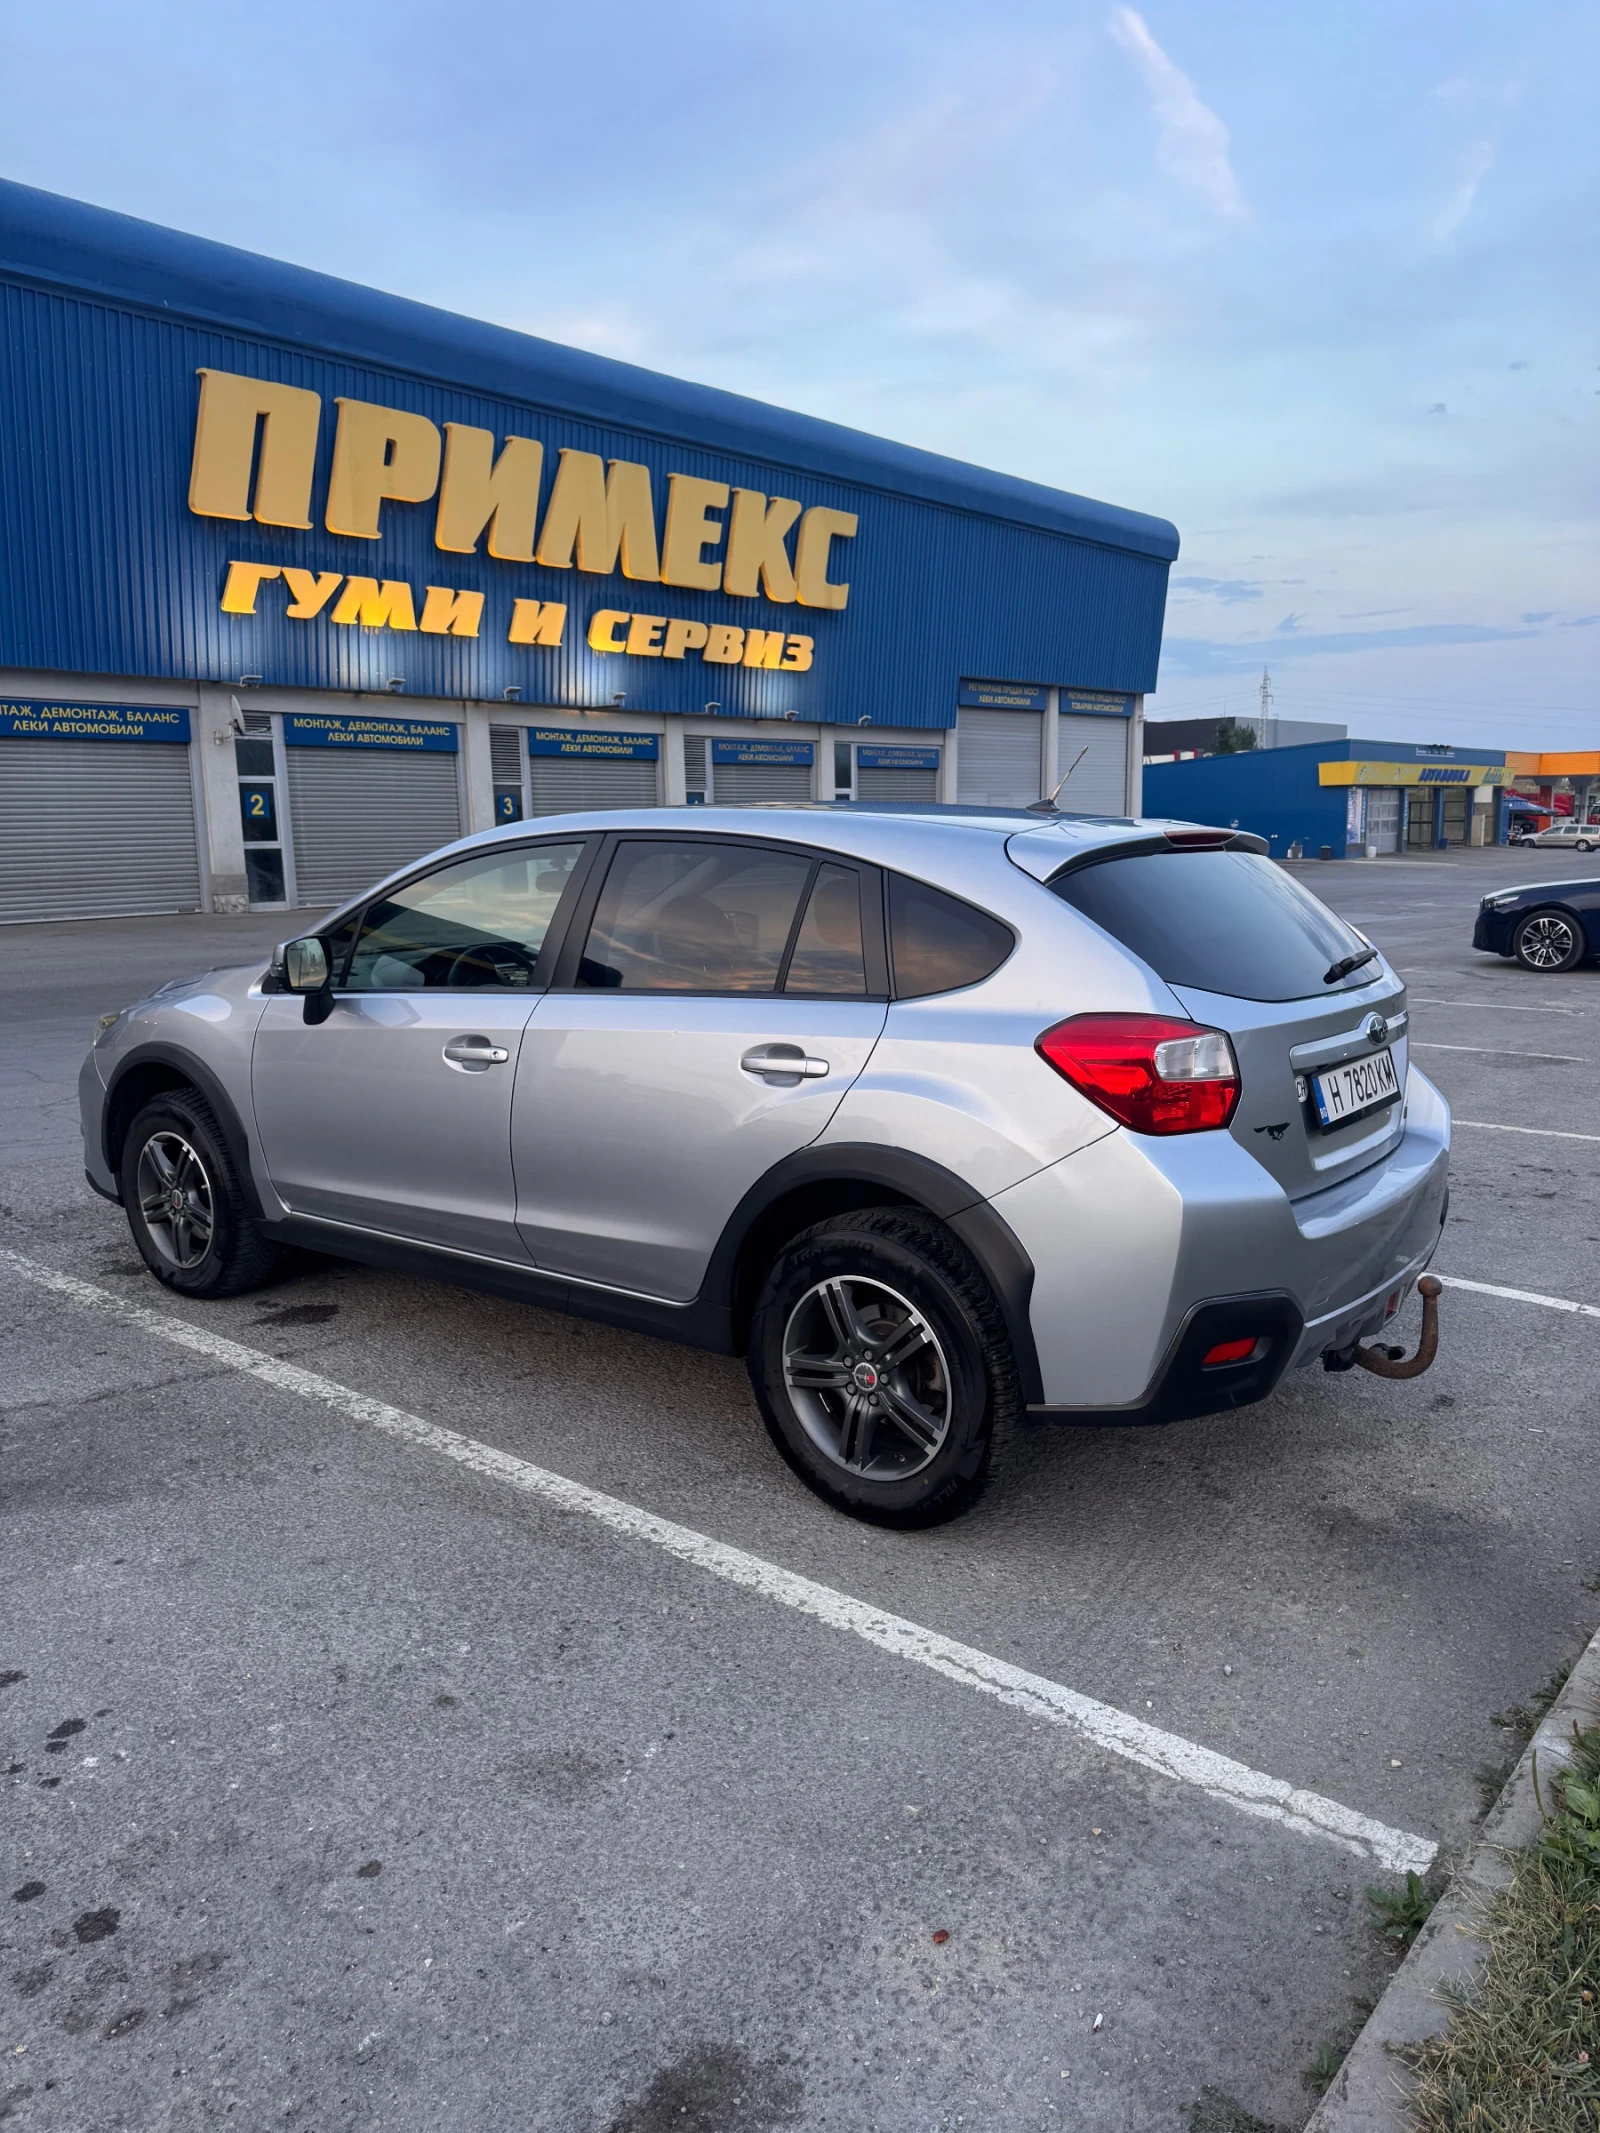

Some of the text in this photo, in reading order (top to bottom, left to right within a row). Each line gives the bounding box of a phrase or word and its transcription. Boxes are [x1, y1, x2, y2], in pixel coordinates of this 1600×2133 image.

[188, 367, 859, 610] ПРИМЕКС
[221, 559, 814, 672] ГУМИ И СЕРВИЗ
[41, 707, 122, 722] ДЕМОНТАЖ,
[127, 711, 179, 724] БАЛАНС
[13, 720, 144, 735] ЛЕКИ АВТОМОБИЛИ
[293, 718, 450, 736] МОНТАЖ, ДЕМОНТАЖ, БАЛАНС
[328, 732, 424, 746] ЛЕКИ АВТОМОБИЛИ
[536, 731, 653, 745] МОНТАЖ, ДЕМОНТАЖ, БАЛАНС
[561, 744, 633, 754] ЛЕКИ АВТОМОБИЛИ
[250, 794, 264, 815] 2
[503, 797, 513, 815] 3
[1296, 1079, 1306, 1098] CH
[1327, 1075, 1344, 1114] H
[1320, 1106, 1328, 1119] BG
